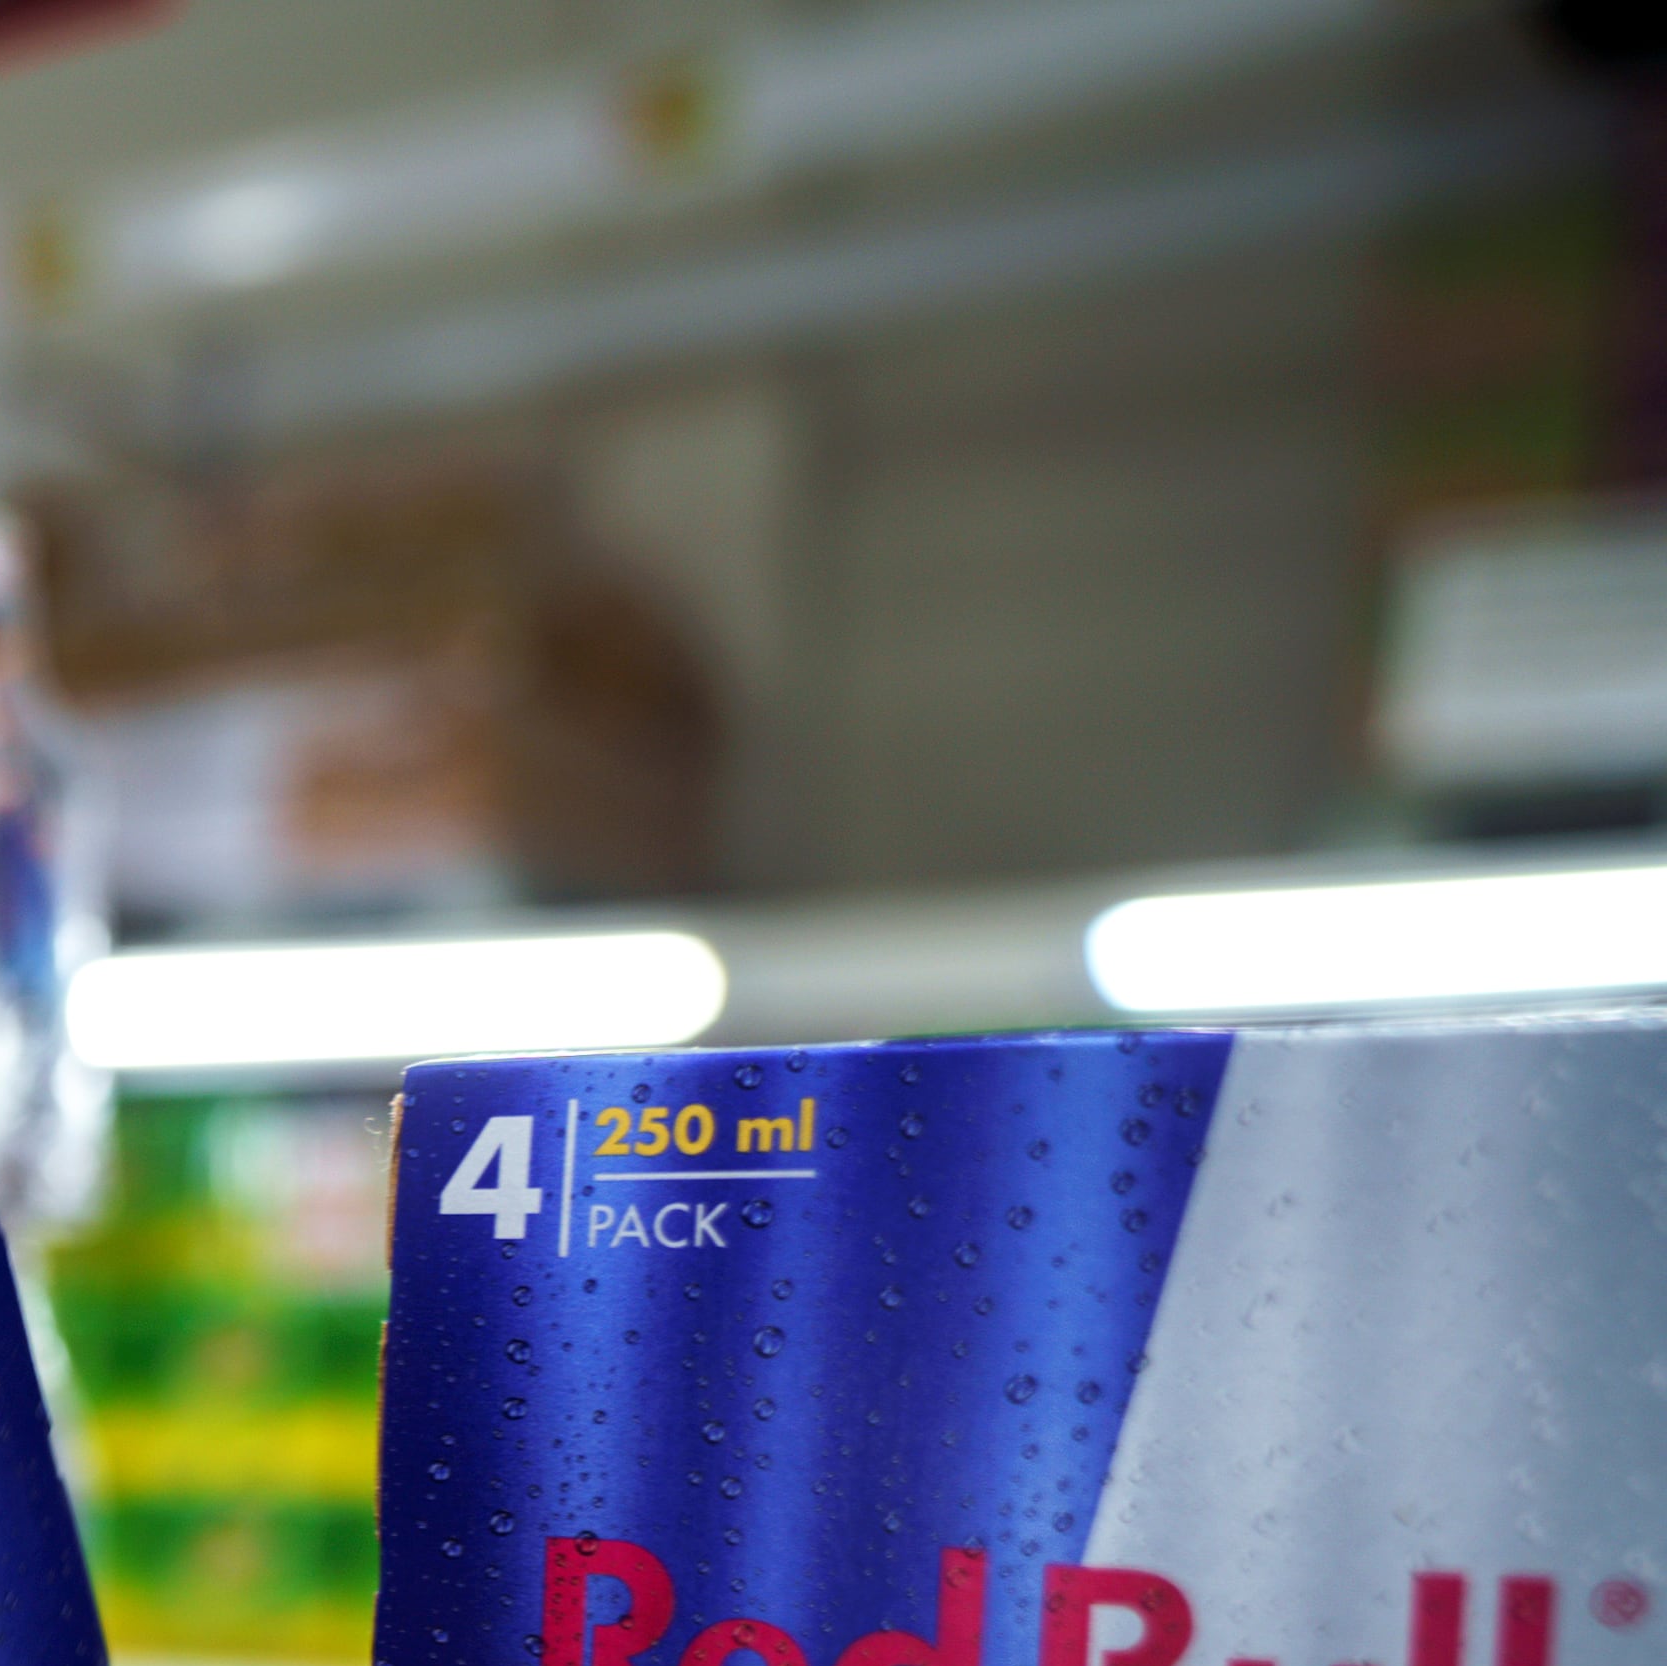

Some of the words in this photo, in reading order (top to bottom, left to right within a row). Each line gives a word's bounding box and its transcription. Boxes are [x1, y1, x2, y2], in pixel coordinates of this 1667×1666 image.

[593, 1103, 715, 1156] 250
[736, 1097, 816, 1153] ml
[439, 1116, 542, 1239] 4
[587, 1202, 729, 1248] PACK
